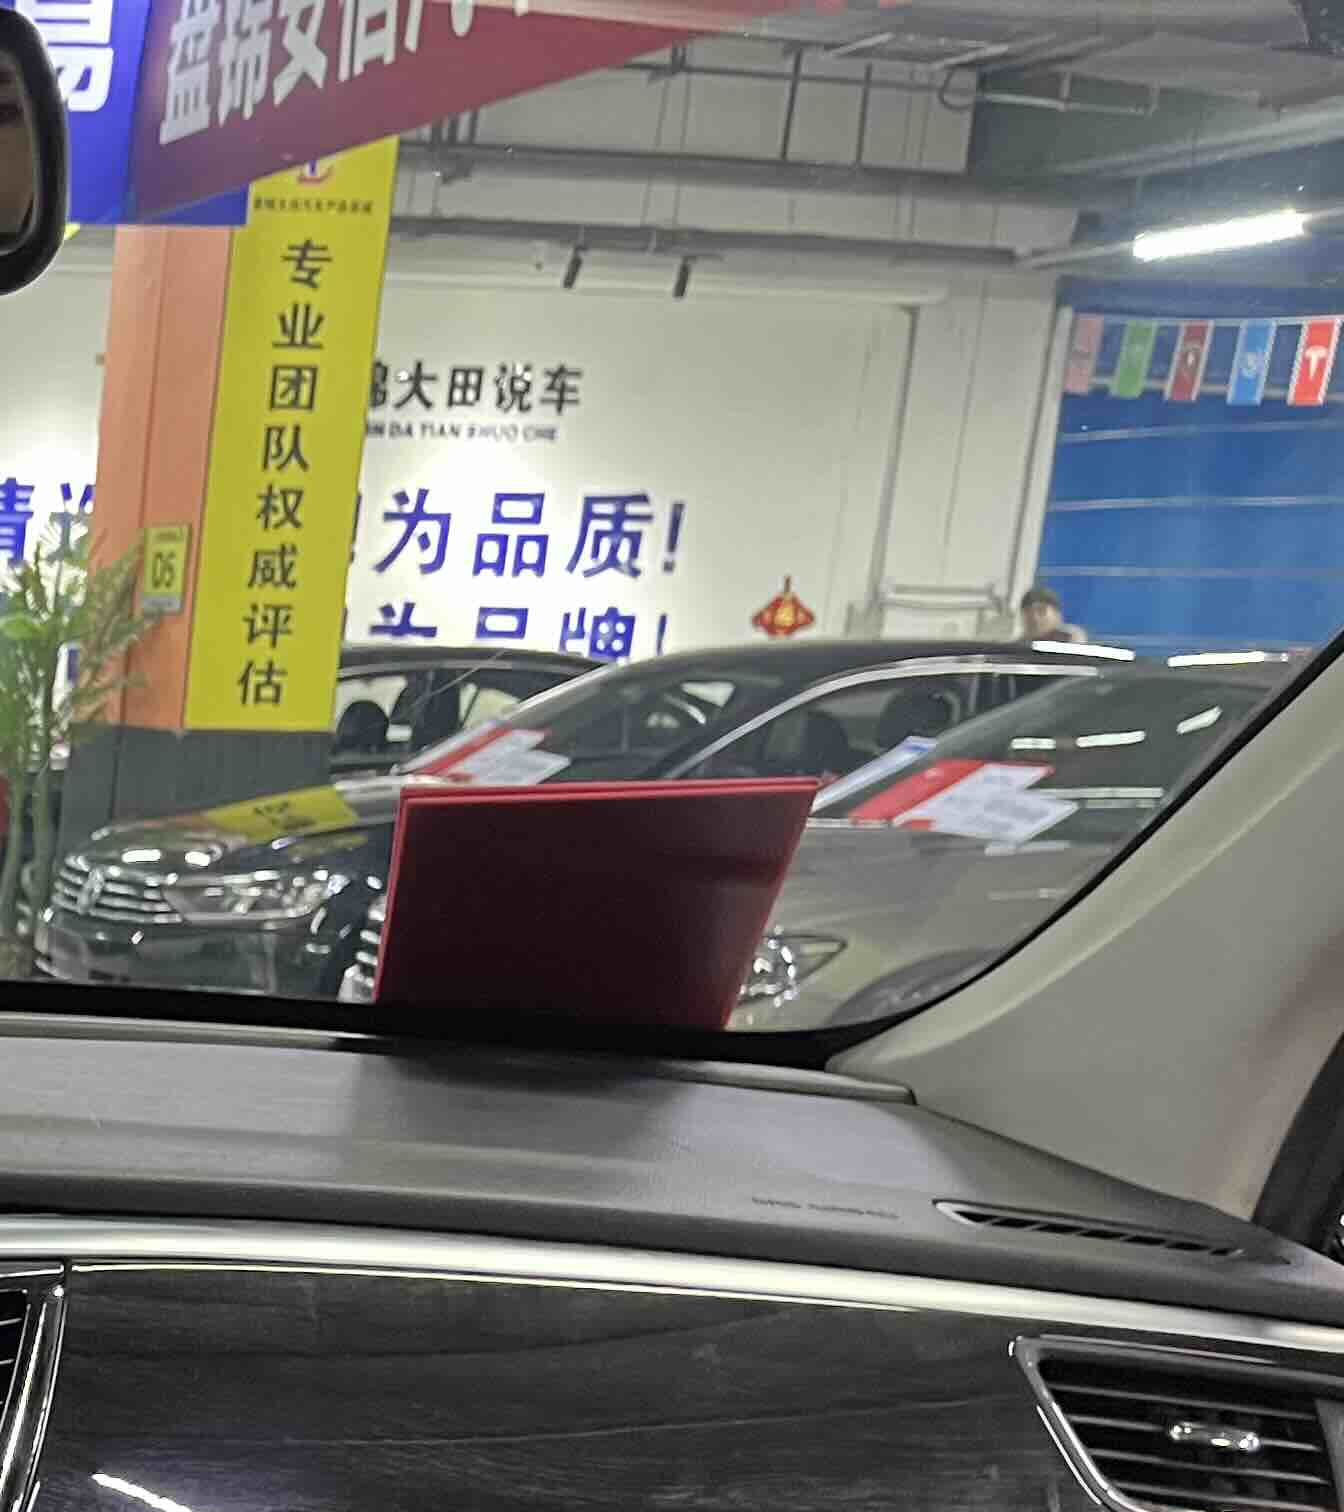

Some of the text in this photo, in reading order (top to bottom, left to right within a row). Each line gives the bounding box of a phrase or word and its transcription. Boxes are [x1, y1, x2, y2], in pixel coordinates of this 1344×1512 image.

[237, 239, 333, 705] 专业团队权威评估
